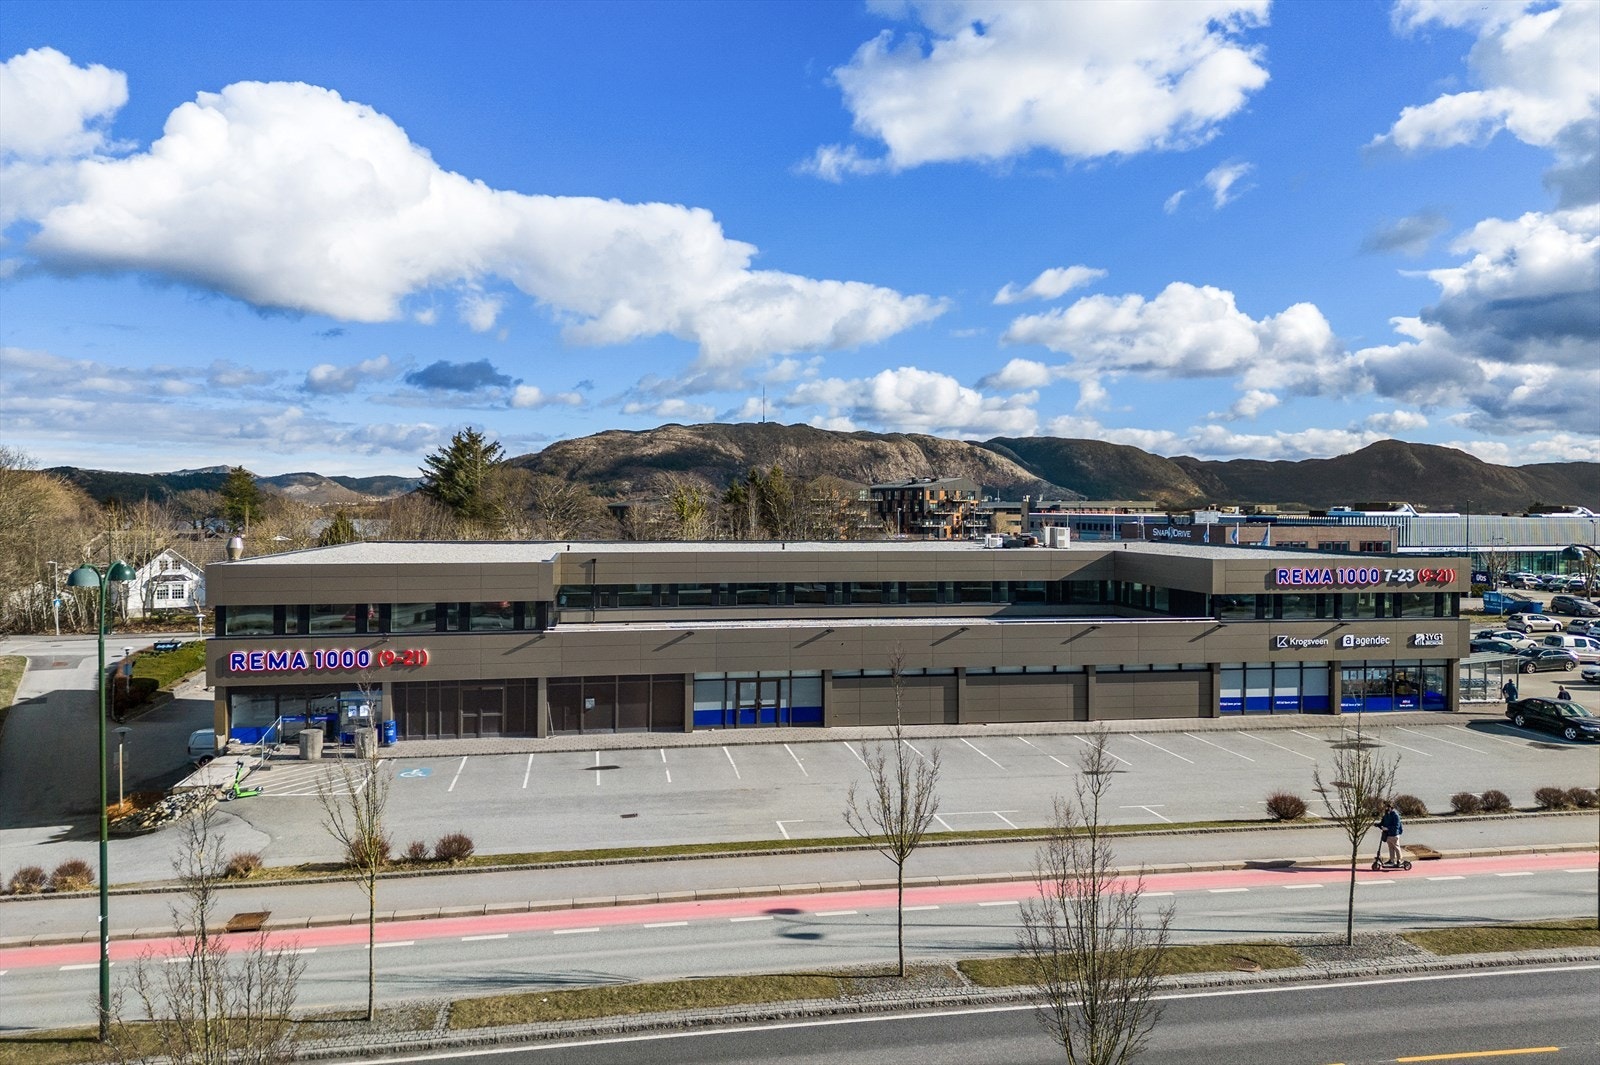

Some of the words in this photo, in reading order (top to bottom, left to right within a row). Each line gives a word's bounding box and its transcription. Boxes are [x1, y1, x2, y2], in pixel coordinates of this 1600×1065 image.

[1152, 528, 1168, 537] SNAP
[1174, 529, 1191, 538] DRIVE
[1276, 567, 1333, 585] REMA
[1336, 567, 1380, 584] 1000
[1384, 568, 1414, 582] 7-23
[1417, 568, 1456, 583] (9-21)
[1289, 637, 1329, 647] Krogsveen
[1355, 635, 1391, 646] agendec
[230, 650, 308, 672] REMA
[313, 648, 372, 669] 1000
[377, 648, 429, 668] (9-21)
